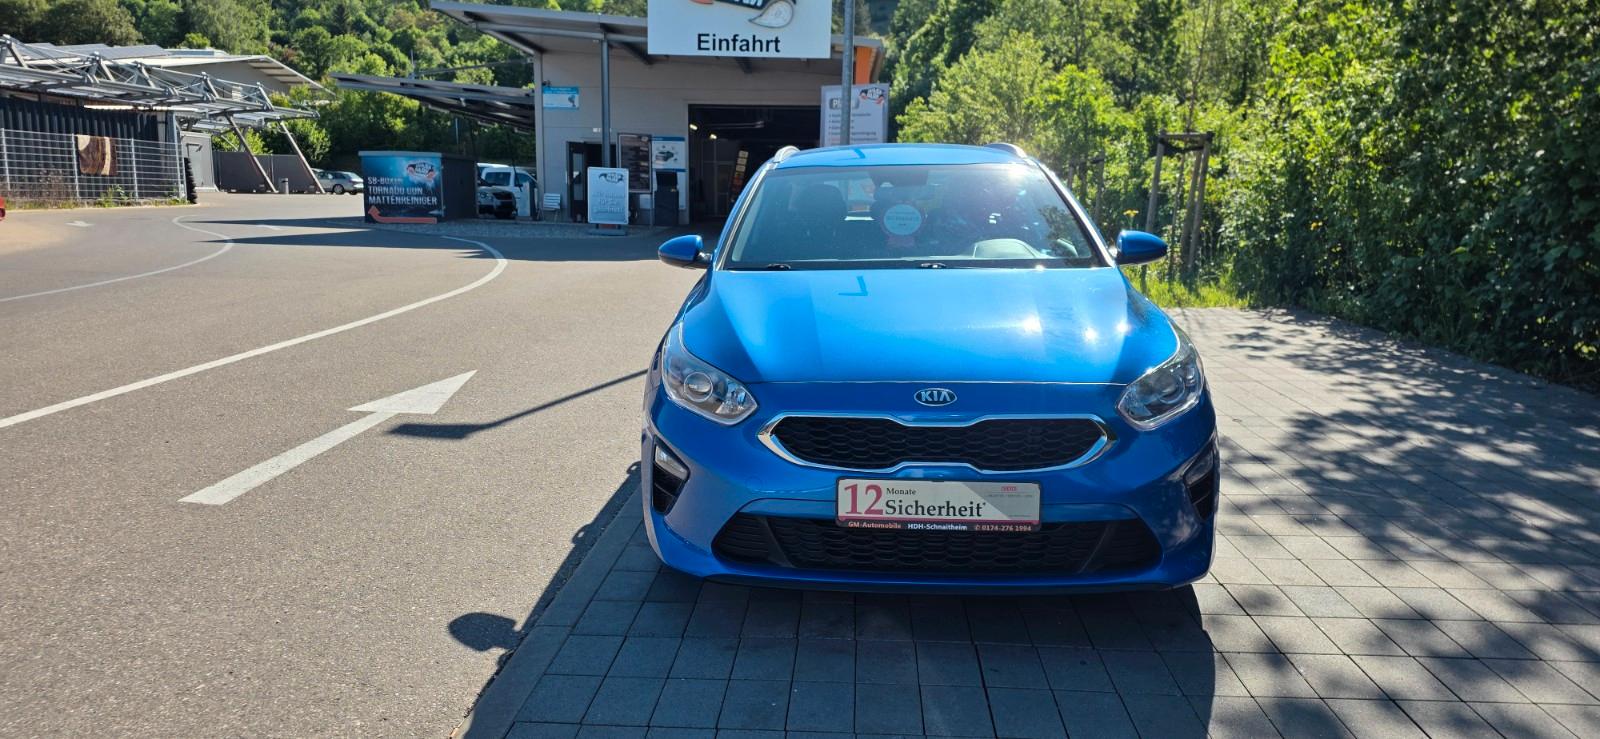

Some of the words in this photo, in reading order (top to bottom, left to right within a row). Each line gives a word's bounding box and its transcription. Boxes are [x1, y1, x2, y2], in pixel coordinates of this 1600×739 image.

[697, 33, 781, 53] Einfahrt
[368, 186, 405, 195] TORNADO
[368, 196, 438, 206] MATTENREINIGER
[921, 390, 951, 402] KIA
[886, 487, 916, 496] Monate
[844, 484, 883, 515] 12
[848, 521, 902, 529] GM-Automobile
[907, 523, 968, 531] HDH-Schnaitheim
